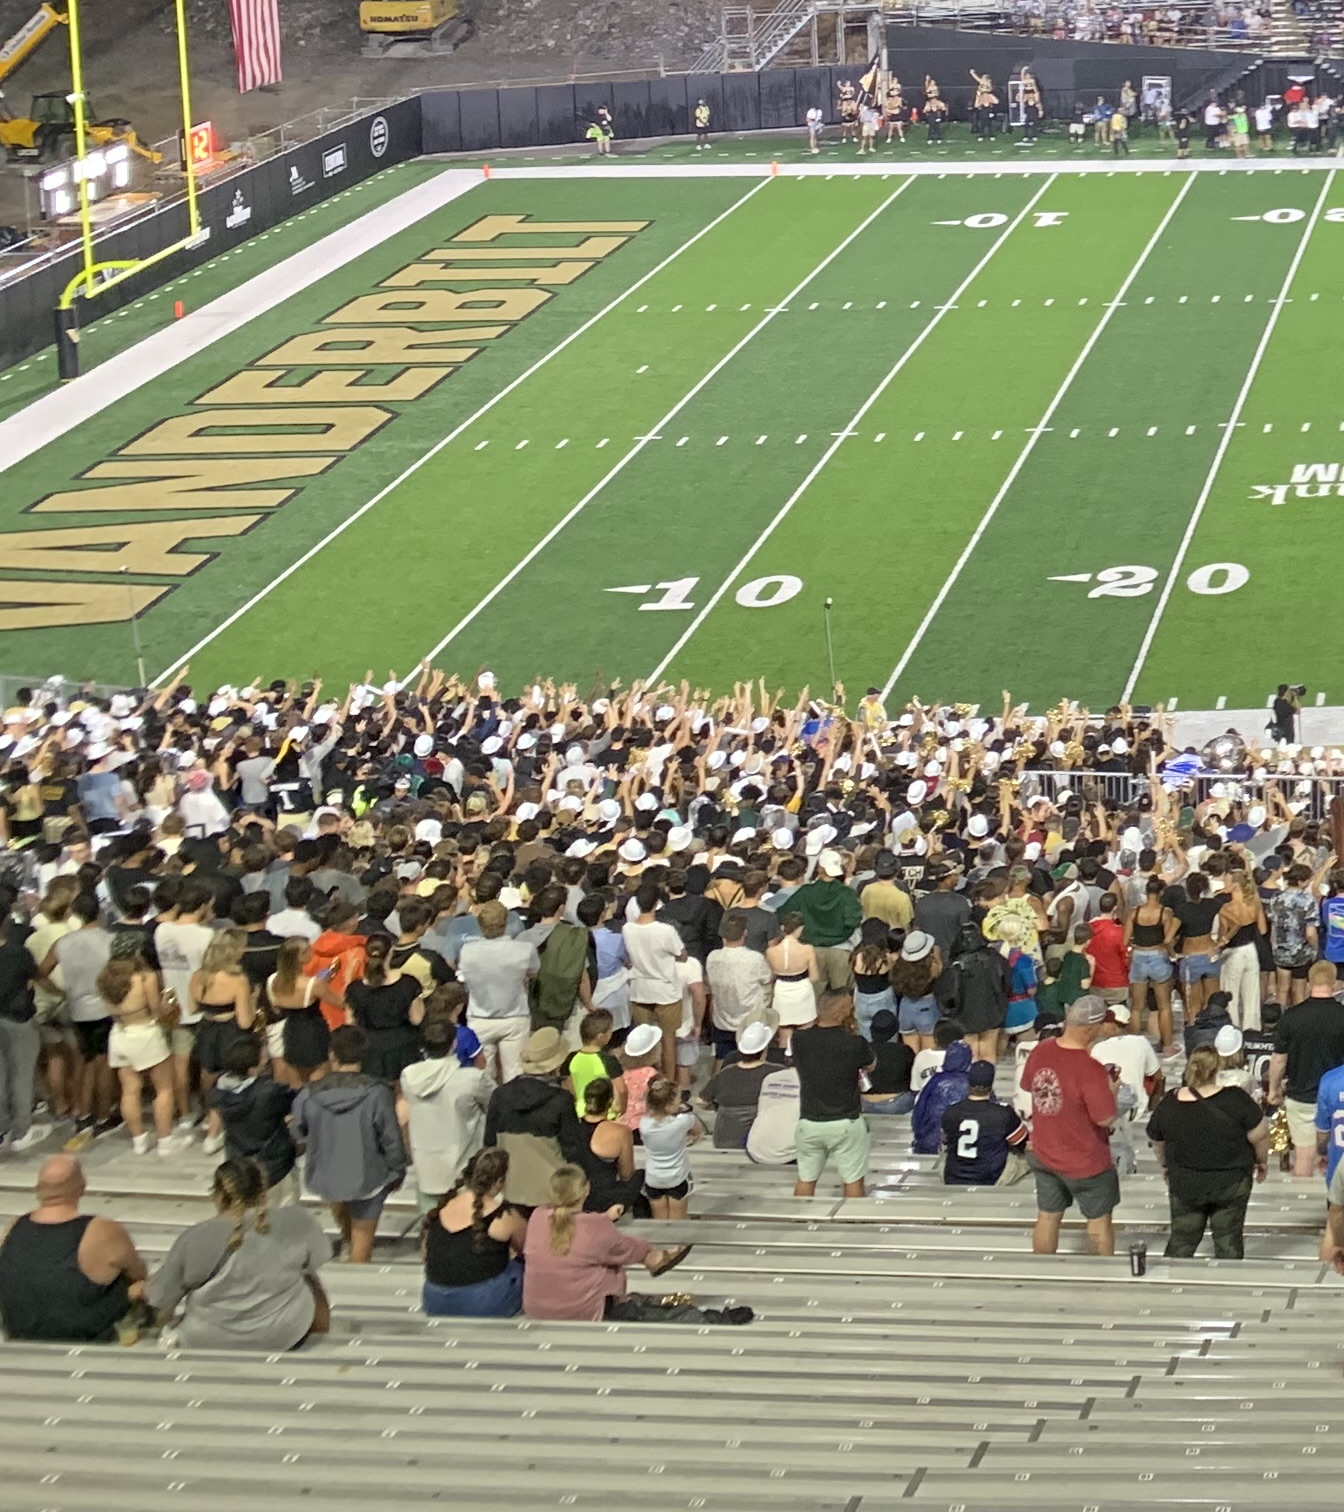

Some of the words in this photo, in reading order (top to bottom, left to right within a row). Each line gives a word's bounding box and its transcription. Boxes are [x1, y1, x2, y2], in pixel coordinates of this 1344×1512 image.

[370, 14, 418, 24] KOMATSU
[637, 574, 803, 611] 10
[1087, 562, 1250, 598] 20
[957, 1119, 980, 1158] 2
